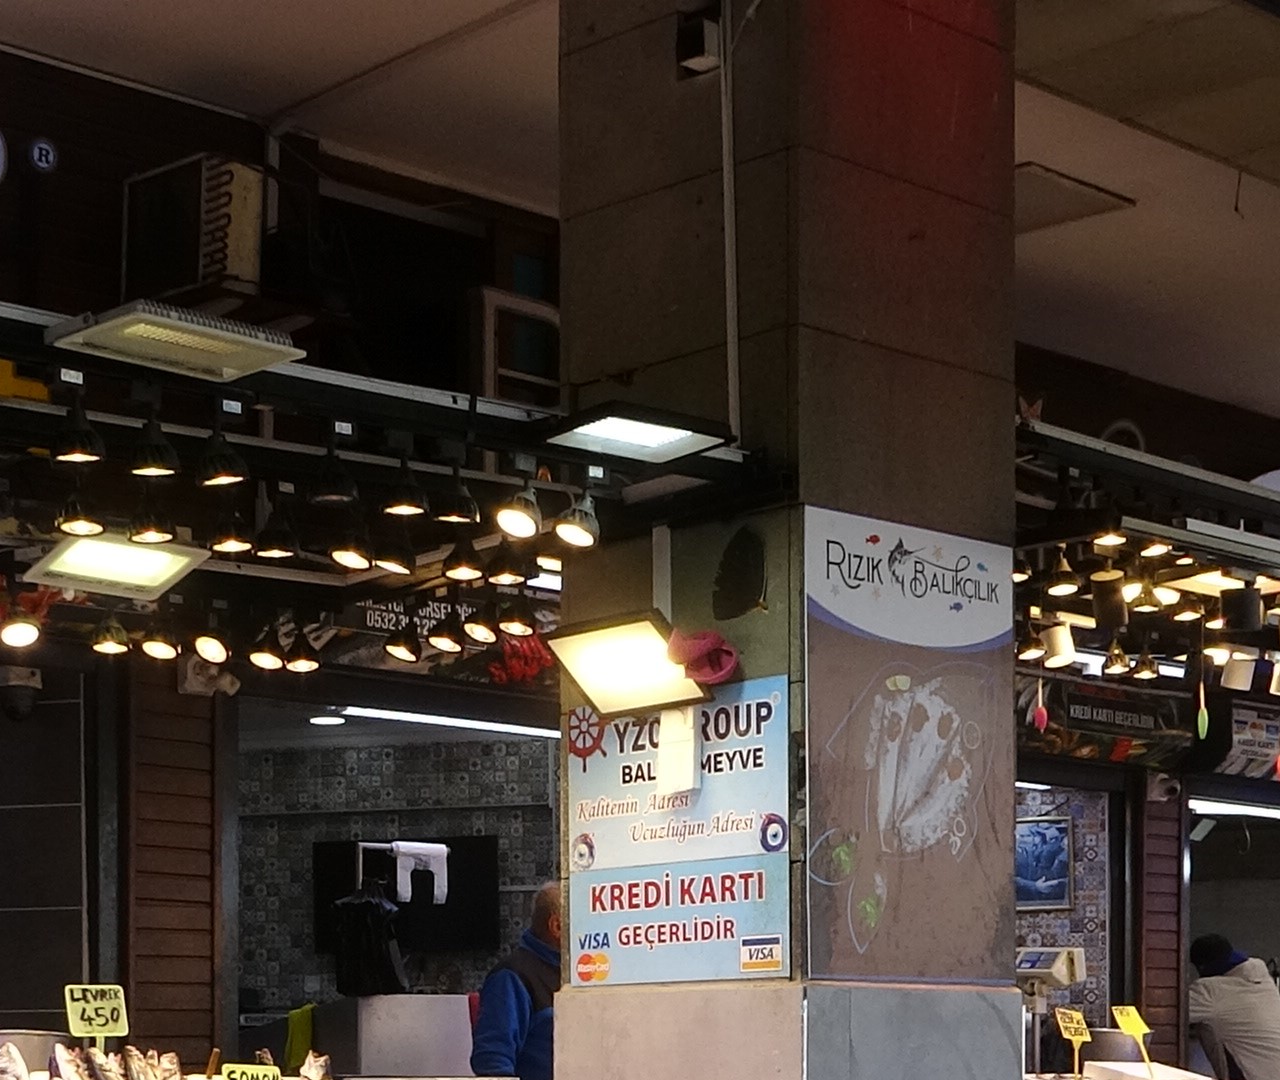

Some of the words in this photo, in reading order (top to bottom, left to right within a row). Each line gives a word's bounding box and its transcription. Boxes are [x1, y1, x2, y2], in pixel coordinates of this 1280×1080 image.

[826, 539, 884, 589] RIZIK
[910, 556, 1000, 604] BALIKÇILIK
[366, 610, 397, 630] 0532
[701, 700, 773, 743] ROUP
[621, 761, 656, 785] BAL
[701, 747, 764, 774] MEYVE
[576, 798, 638, 822] Kalitenin
[629, 817, 705, 844] Ucuzluğun
[706, 812, 756, 834] Adresi
[589, 871, 671, 914] KREDİ
[678, 870, 765, 906] KARTI
[578, 931, 611, 950] VISA
[617, 914, 736, 951] GEÇERLİDİR
[747, 947, 776, 961] VISA
[80, 1006, 120, 1027] 450
